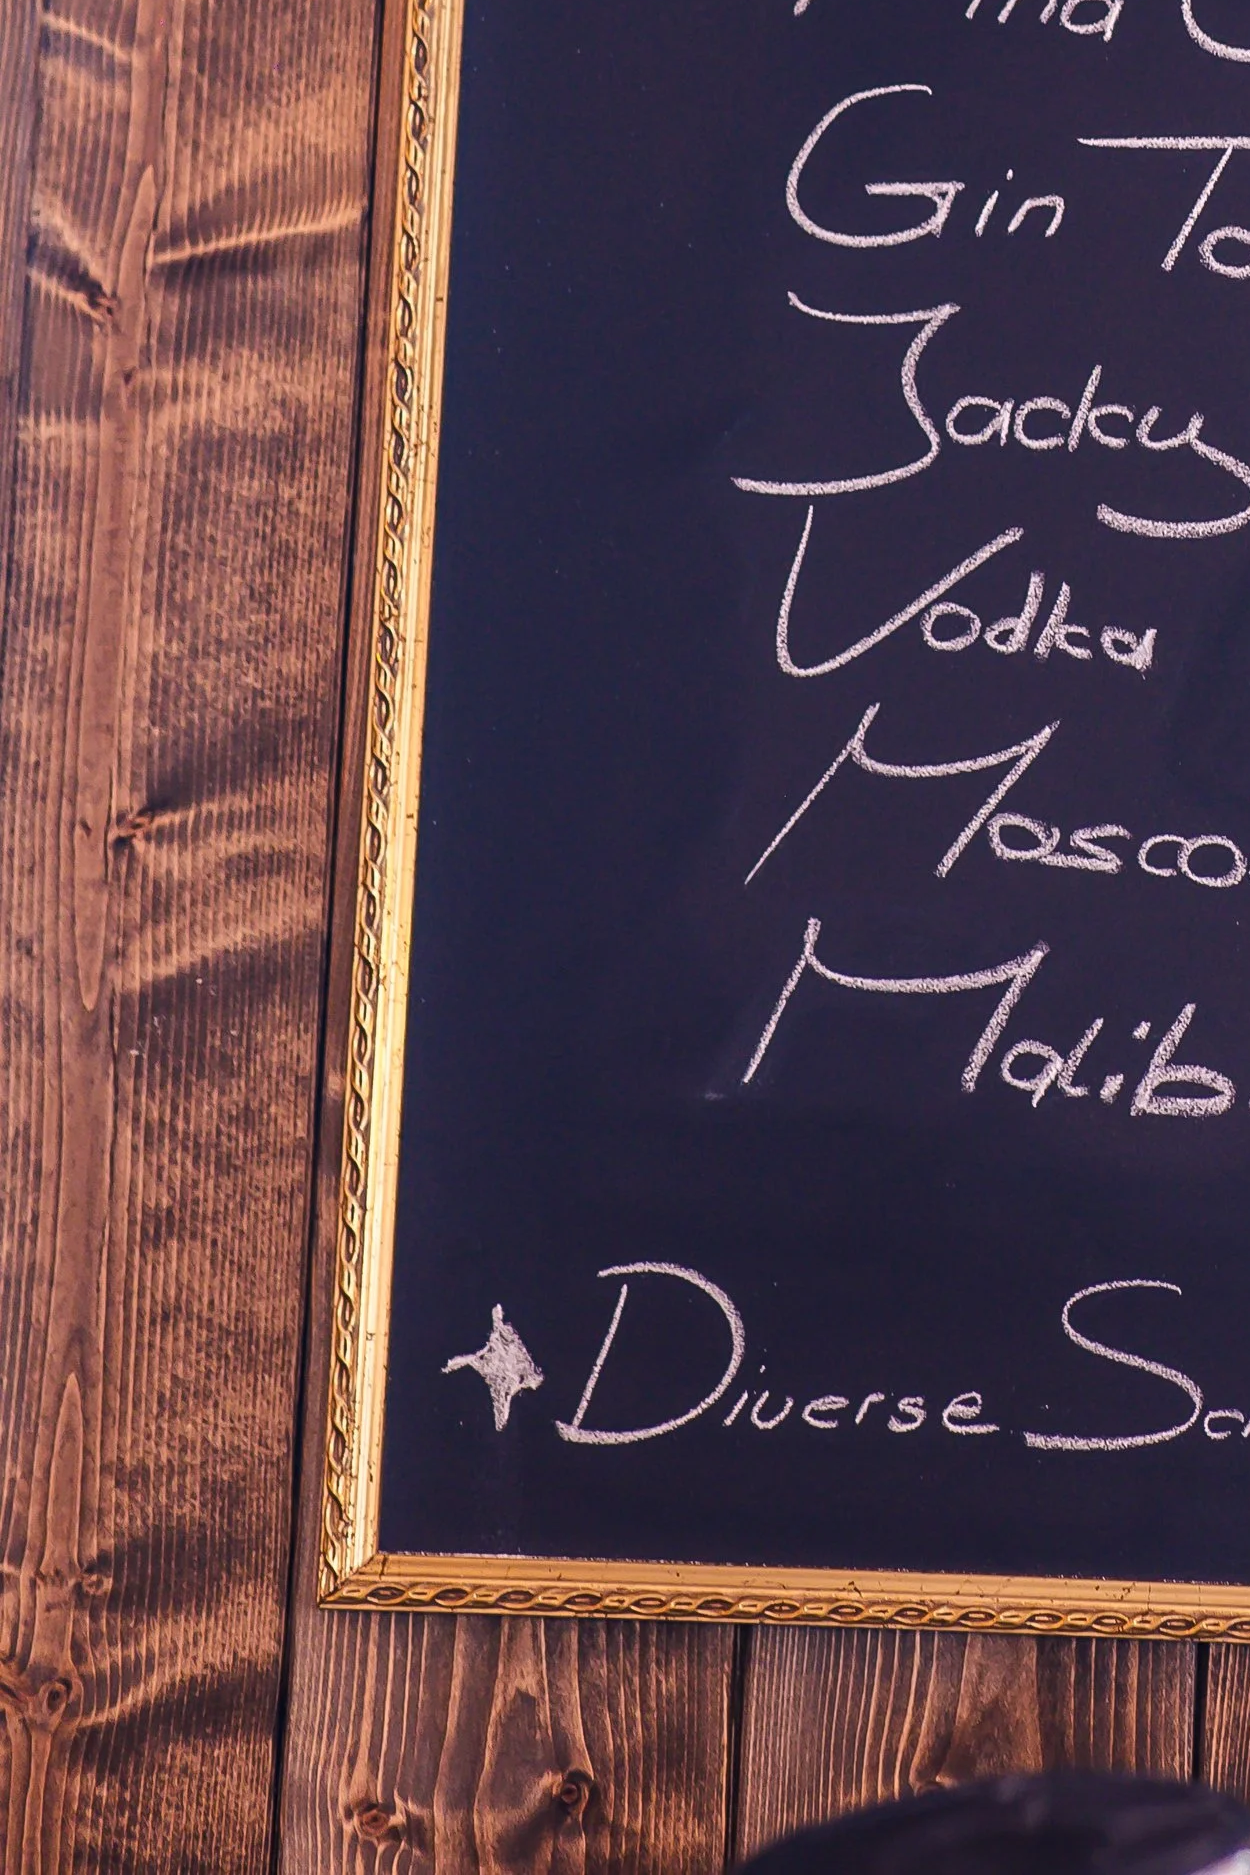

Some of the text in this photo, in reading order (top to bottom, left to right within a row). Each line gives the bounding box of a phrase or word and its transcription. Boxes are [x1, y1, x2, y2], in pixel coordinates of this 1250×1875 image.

[785, 82, 1067, 249] Gin
[775, 504, 1159, 682] Vodka
[554, 1260, 1001, 1446] Diverse
